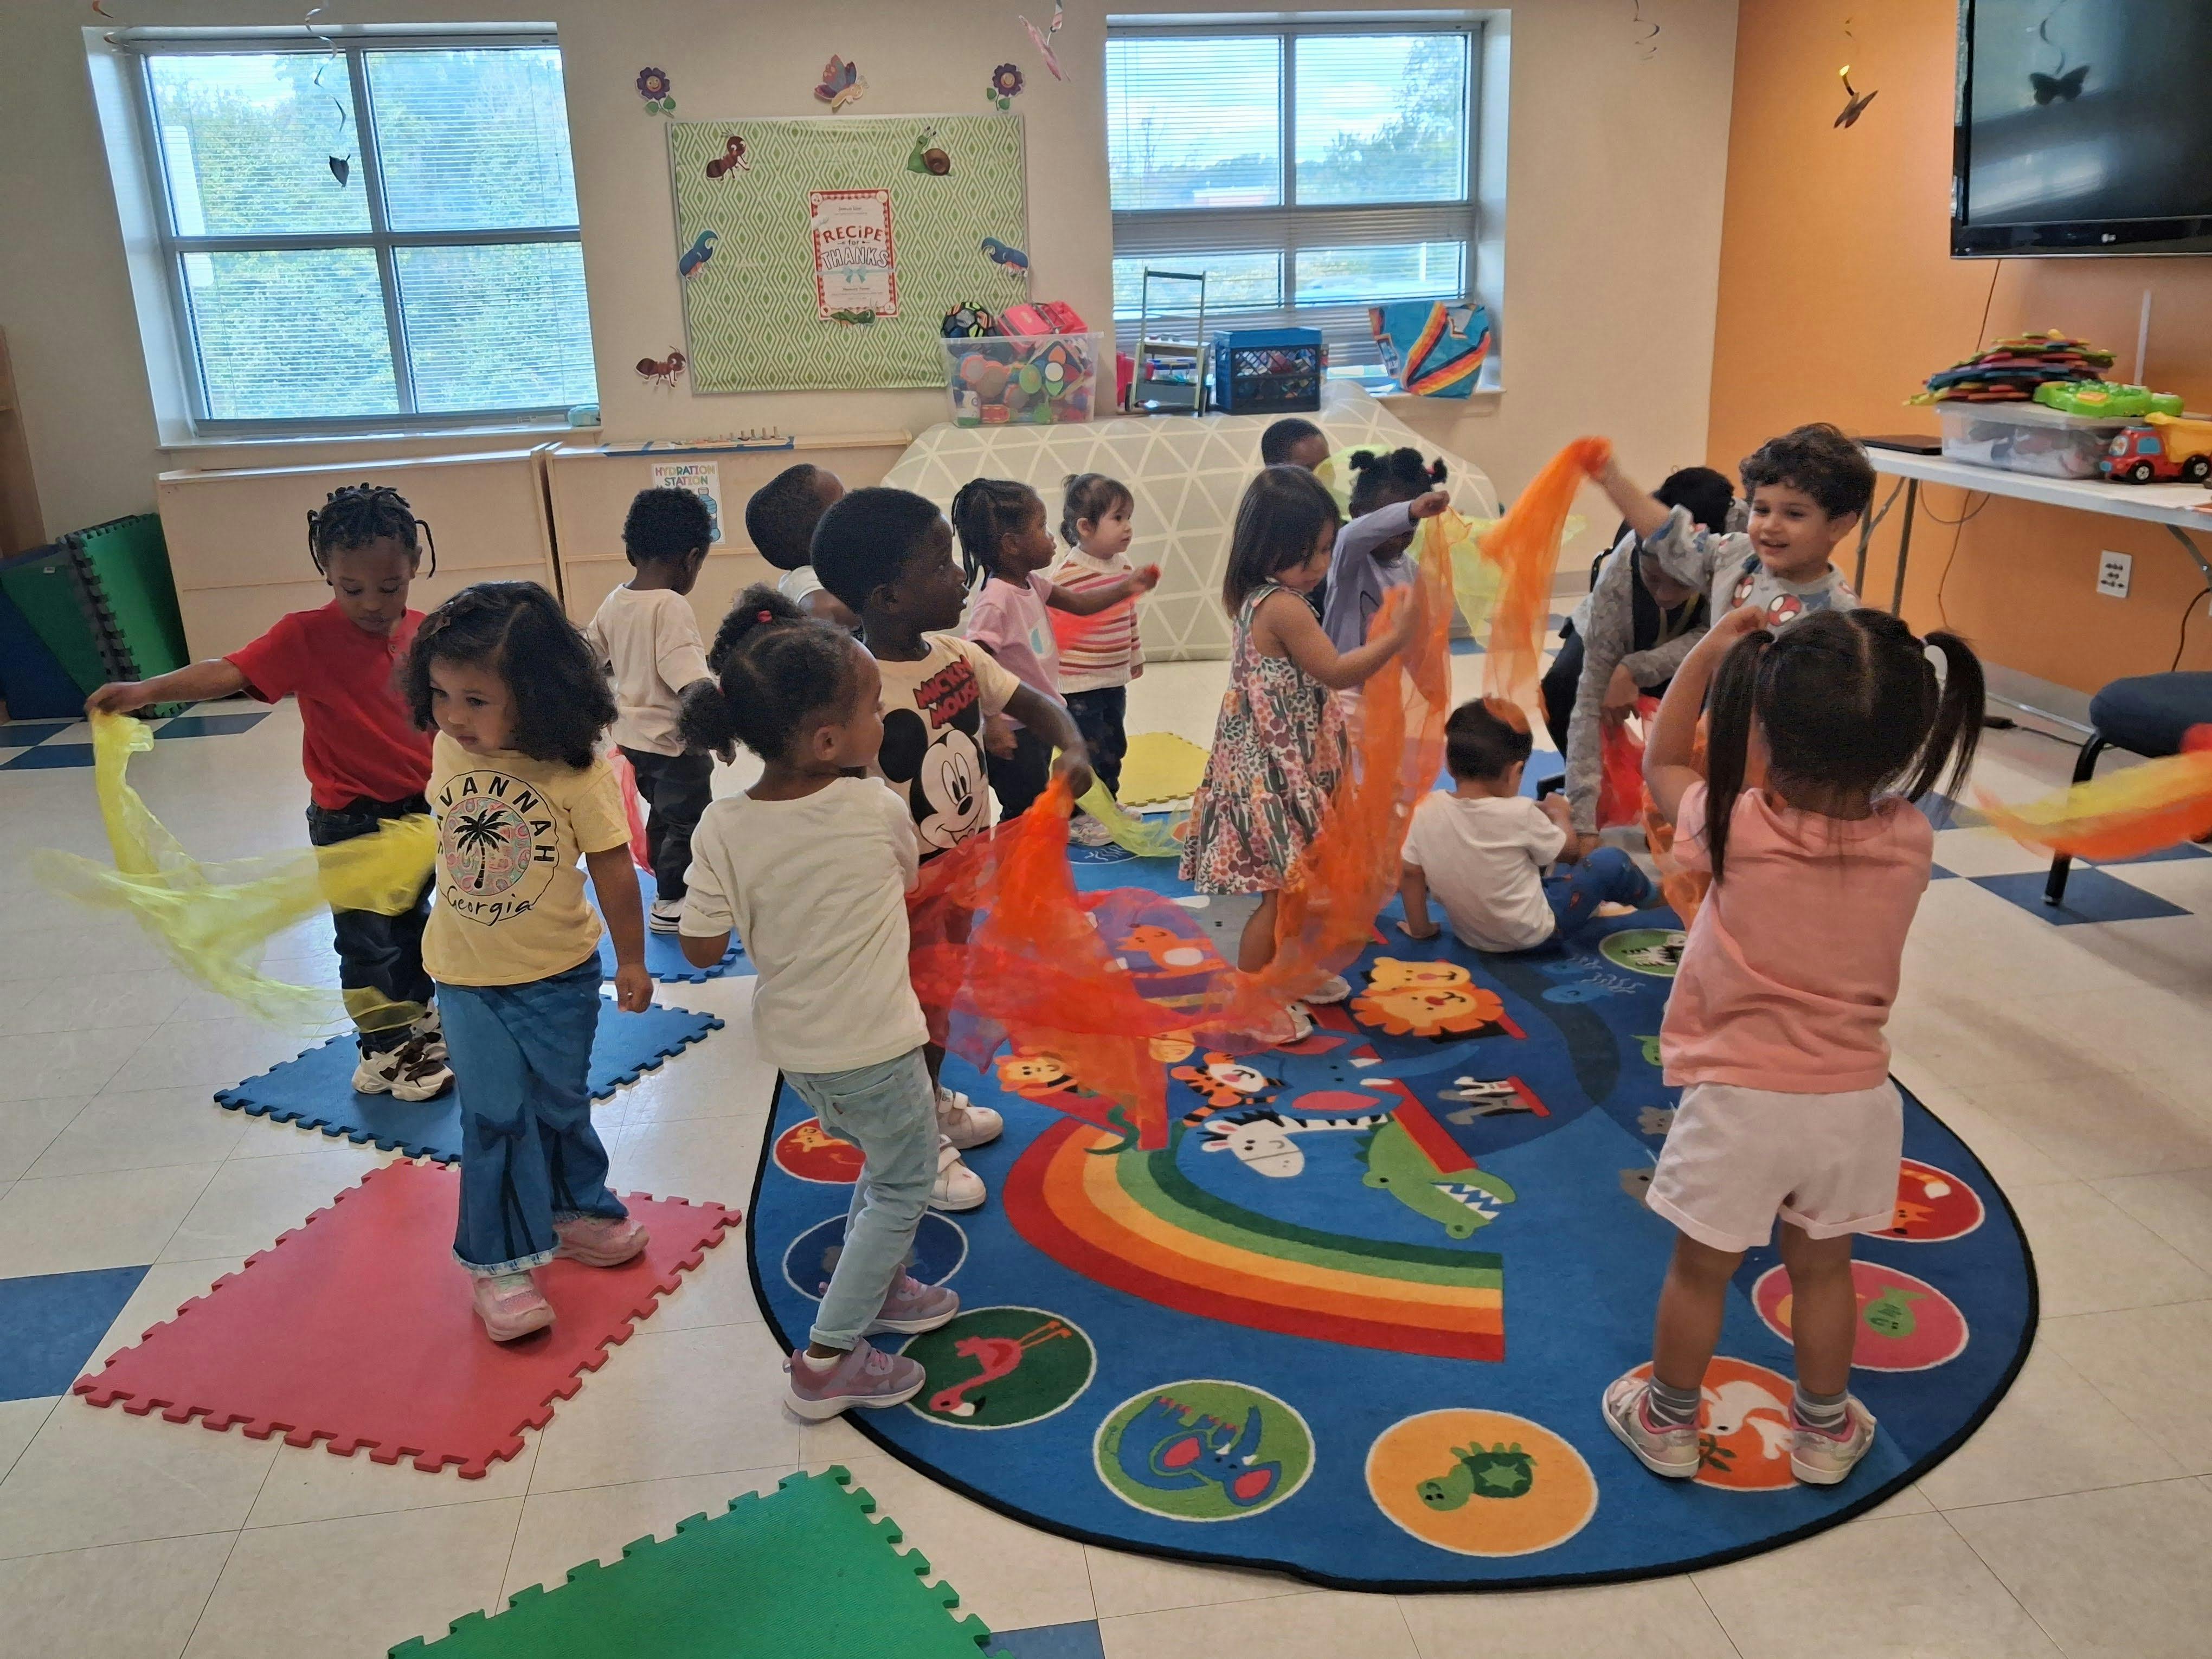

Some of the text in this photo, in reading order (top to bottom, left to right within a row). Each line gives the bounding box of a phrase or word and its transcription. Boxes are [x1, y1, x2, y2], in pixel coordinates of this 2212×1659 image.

[820, 247, 889, 269] THANKS
[655, 465, 715, 476] HYDRATION
[665, 476, 708, 486] STATION
[448, 885, 535, 927] Georgia
